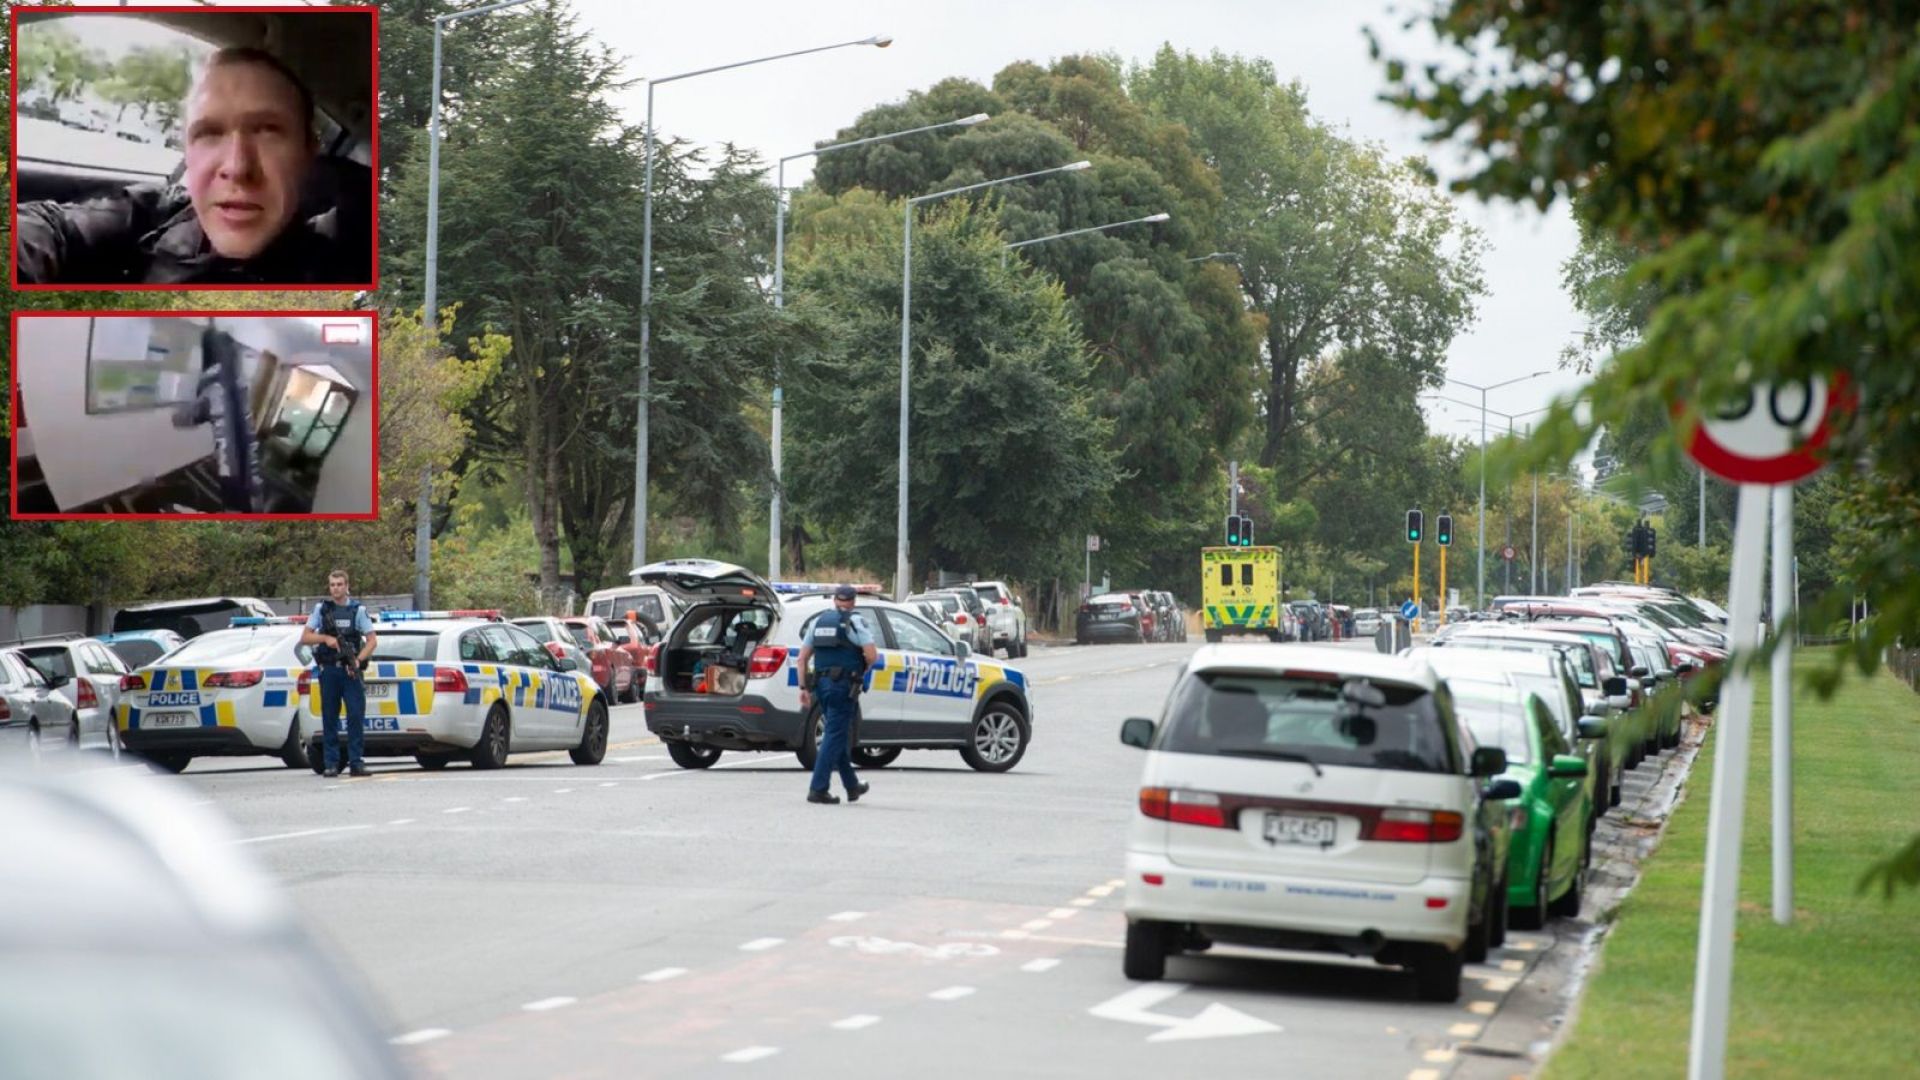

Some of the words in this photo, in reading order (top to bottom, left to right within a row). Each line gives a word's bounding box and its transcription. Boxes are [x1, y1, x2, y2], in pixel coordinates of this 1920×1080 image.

[1716, 374, 1813, 428] 0
[549, 677, 578, 708] POLICE
[919, 661, 975, 693] POLICE
[150, 693, 199, 705] POLICE
